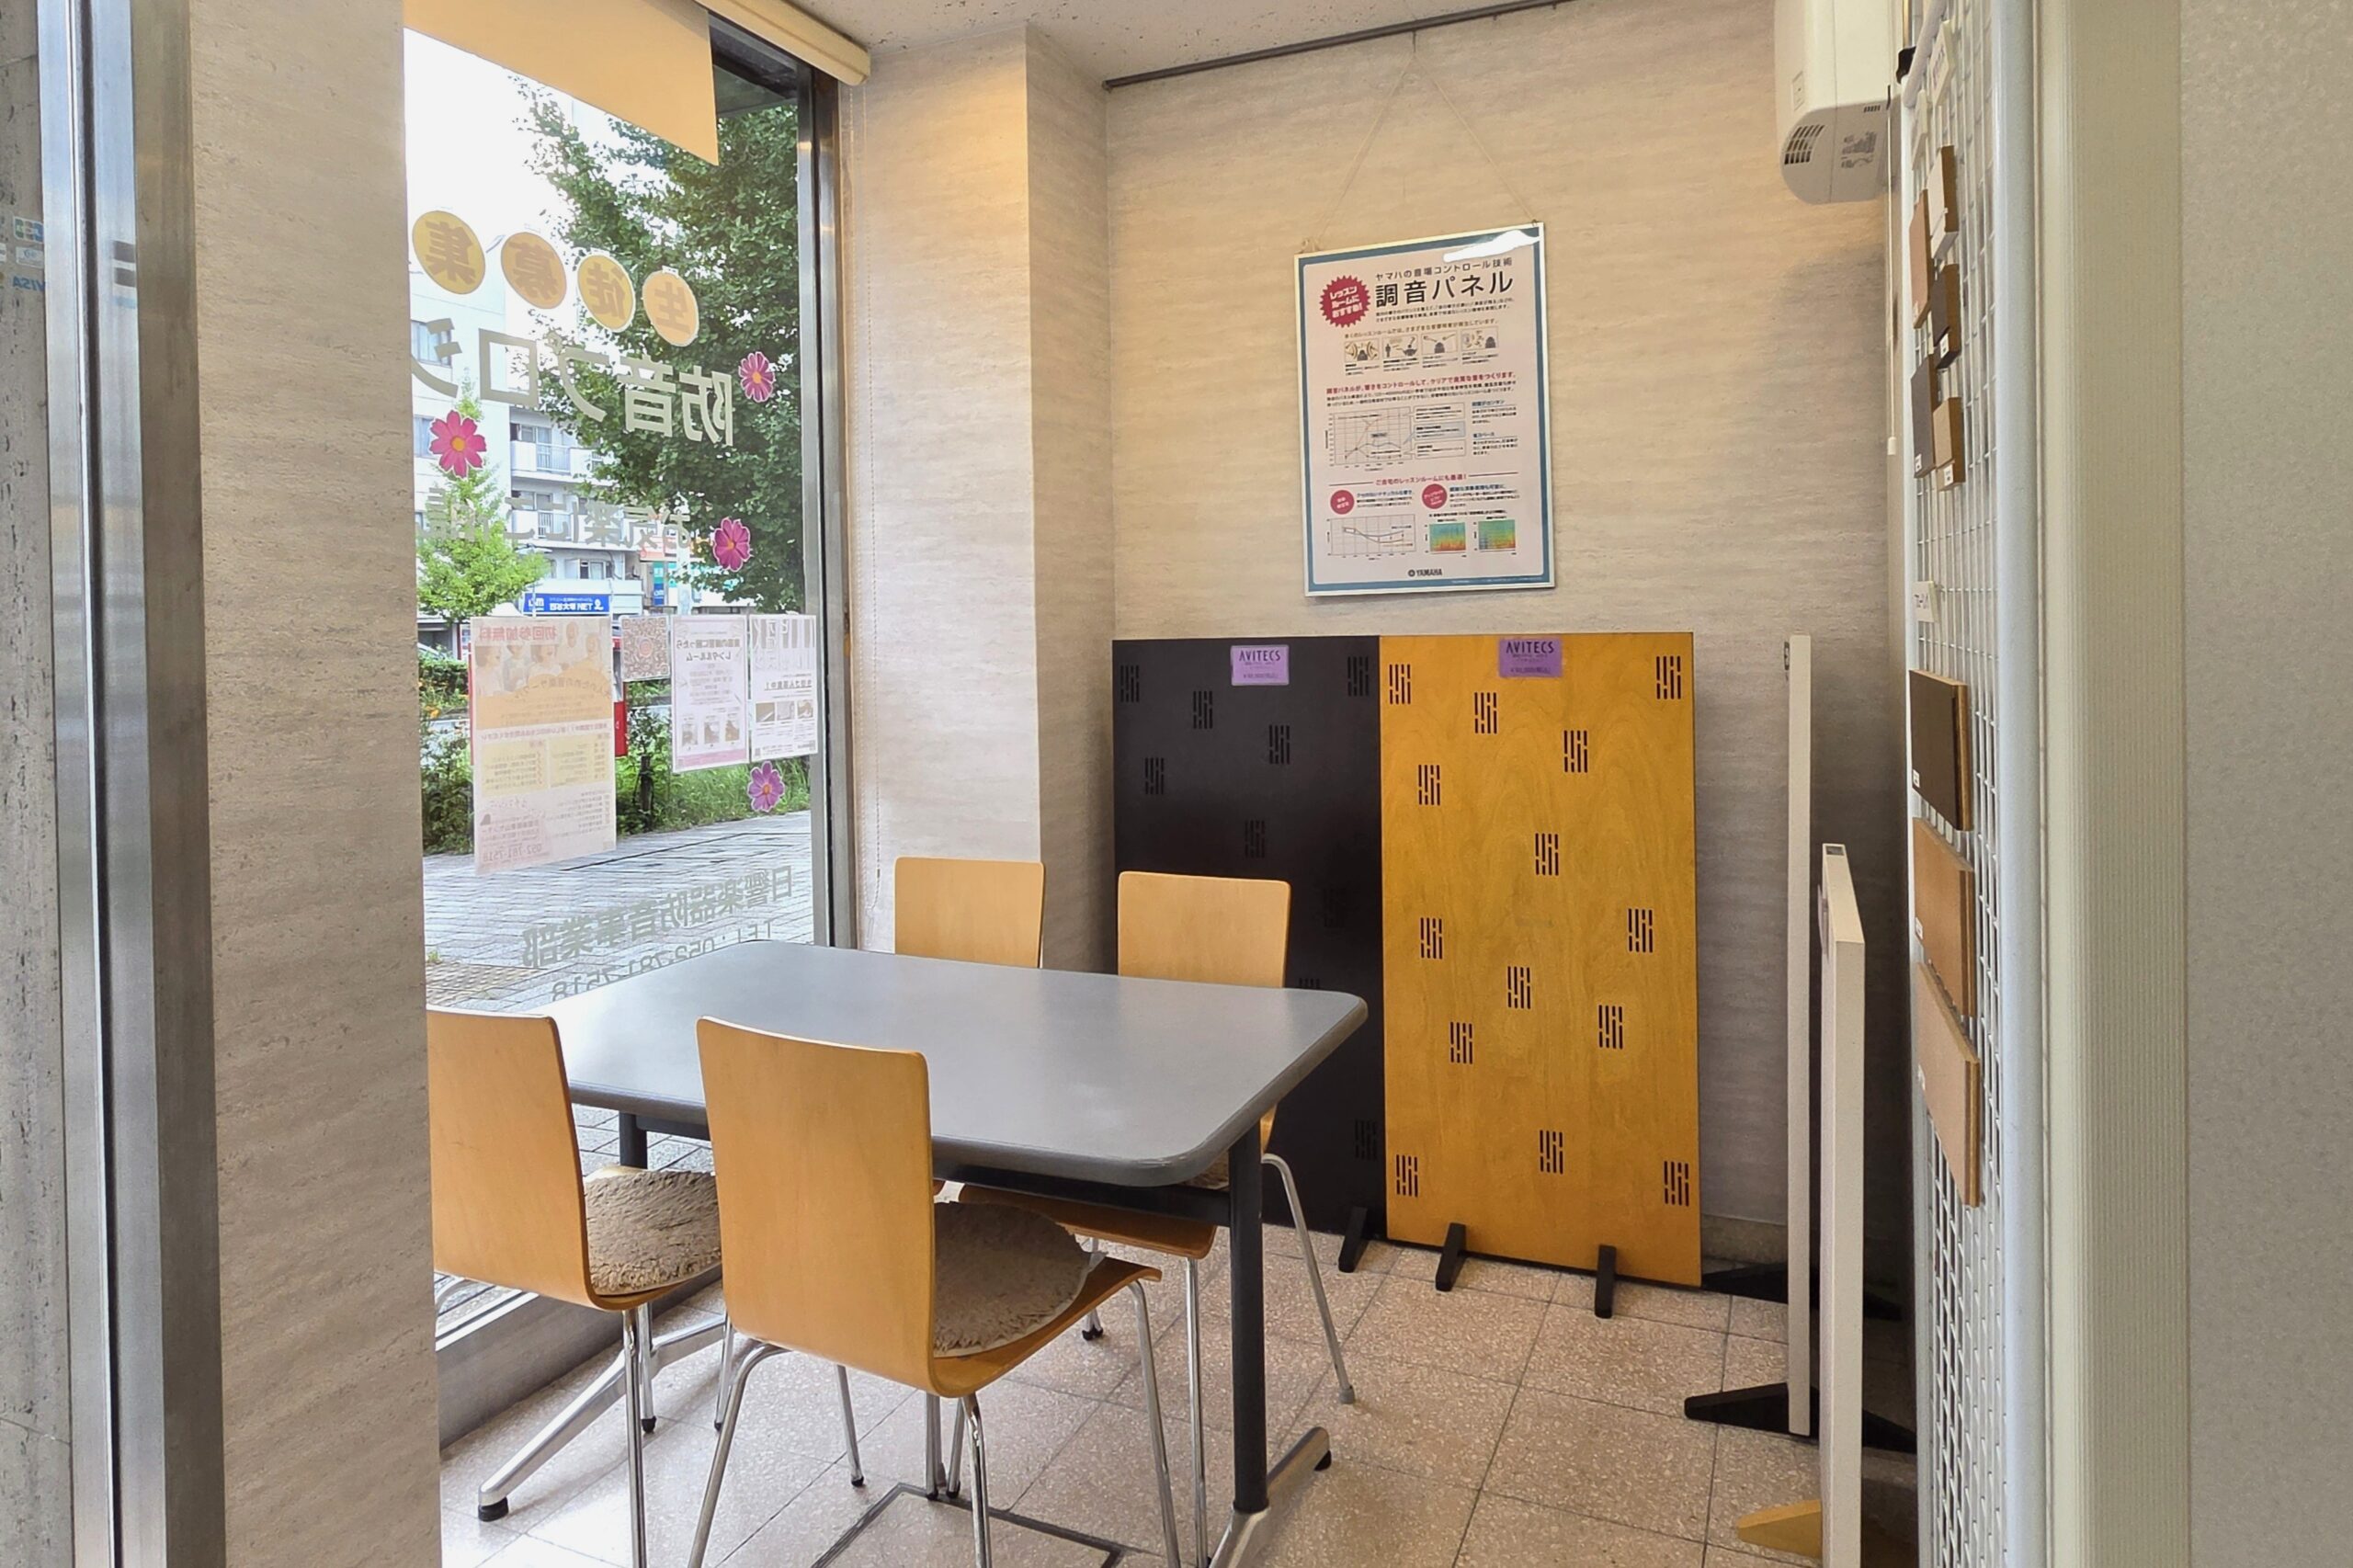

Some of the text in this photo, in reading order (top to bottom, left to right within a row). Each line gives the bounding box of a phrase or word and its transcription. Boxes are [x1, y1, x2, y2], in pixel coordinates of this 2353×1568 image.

[1375, 256, 1513, 281] ヤマハの音場コントロール技術
[1329, 286, 1358, 301] レッスン
[1374, 270, 1514, 309] 調音パネル
[1415, 568, 1443, 576] YAMAHA
[1506, 641, 1555, 653] AVITECS
[1238, 650, 1281, 662] AVITECS
